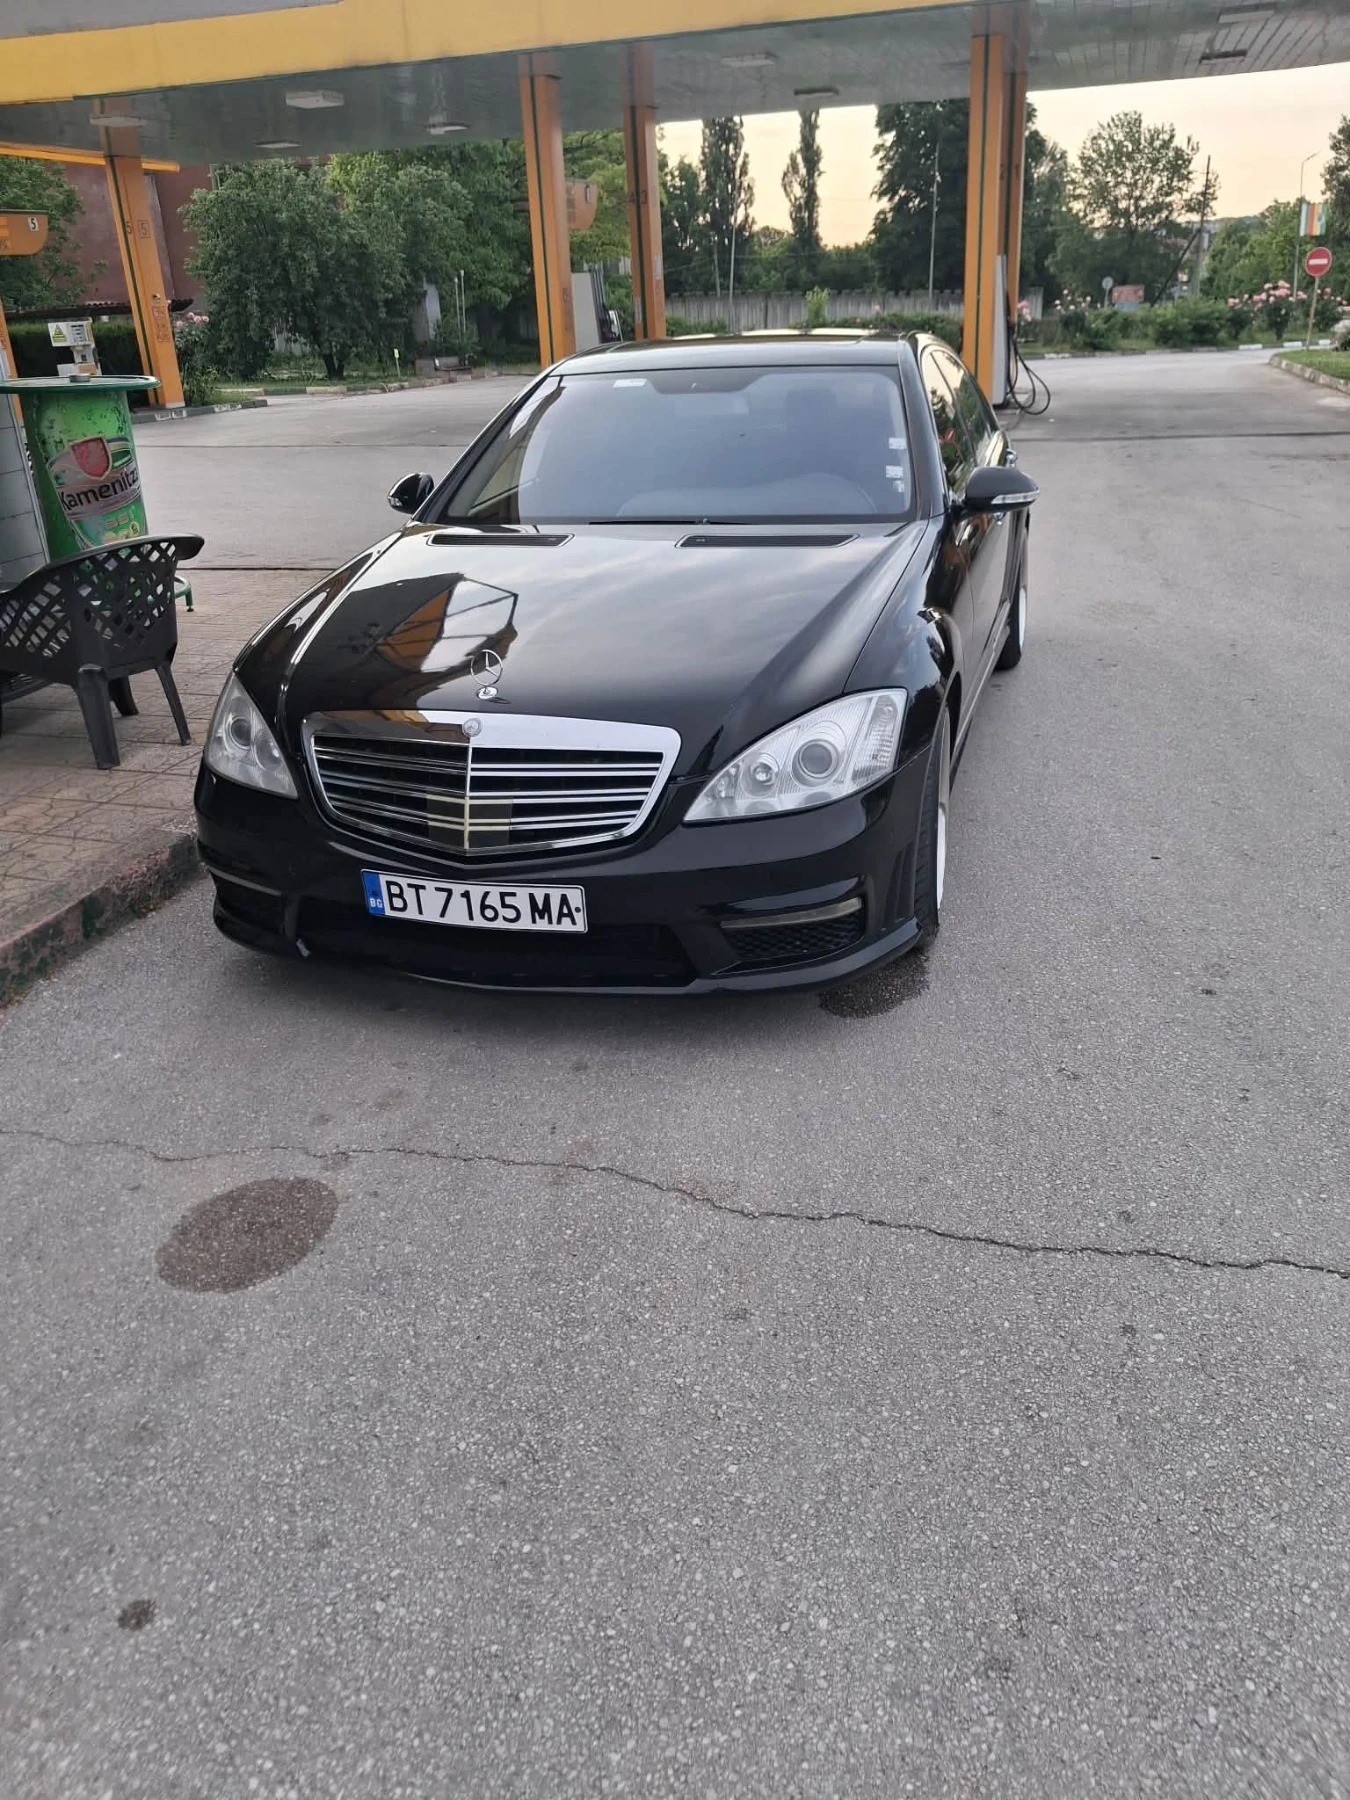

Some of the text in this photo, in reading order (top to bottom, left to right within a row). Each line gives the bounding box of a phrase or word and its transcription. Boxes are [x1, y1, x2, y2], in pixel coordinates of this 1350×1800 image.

[30, 217, 37, 230] 5
[57, 467, 139, 511] Kamenitz
[369, 897, 384, 909] BG
